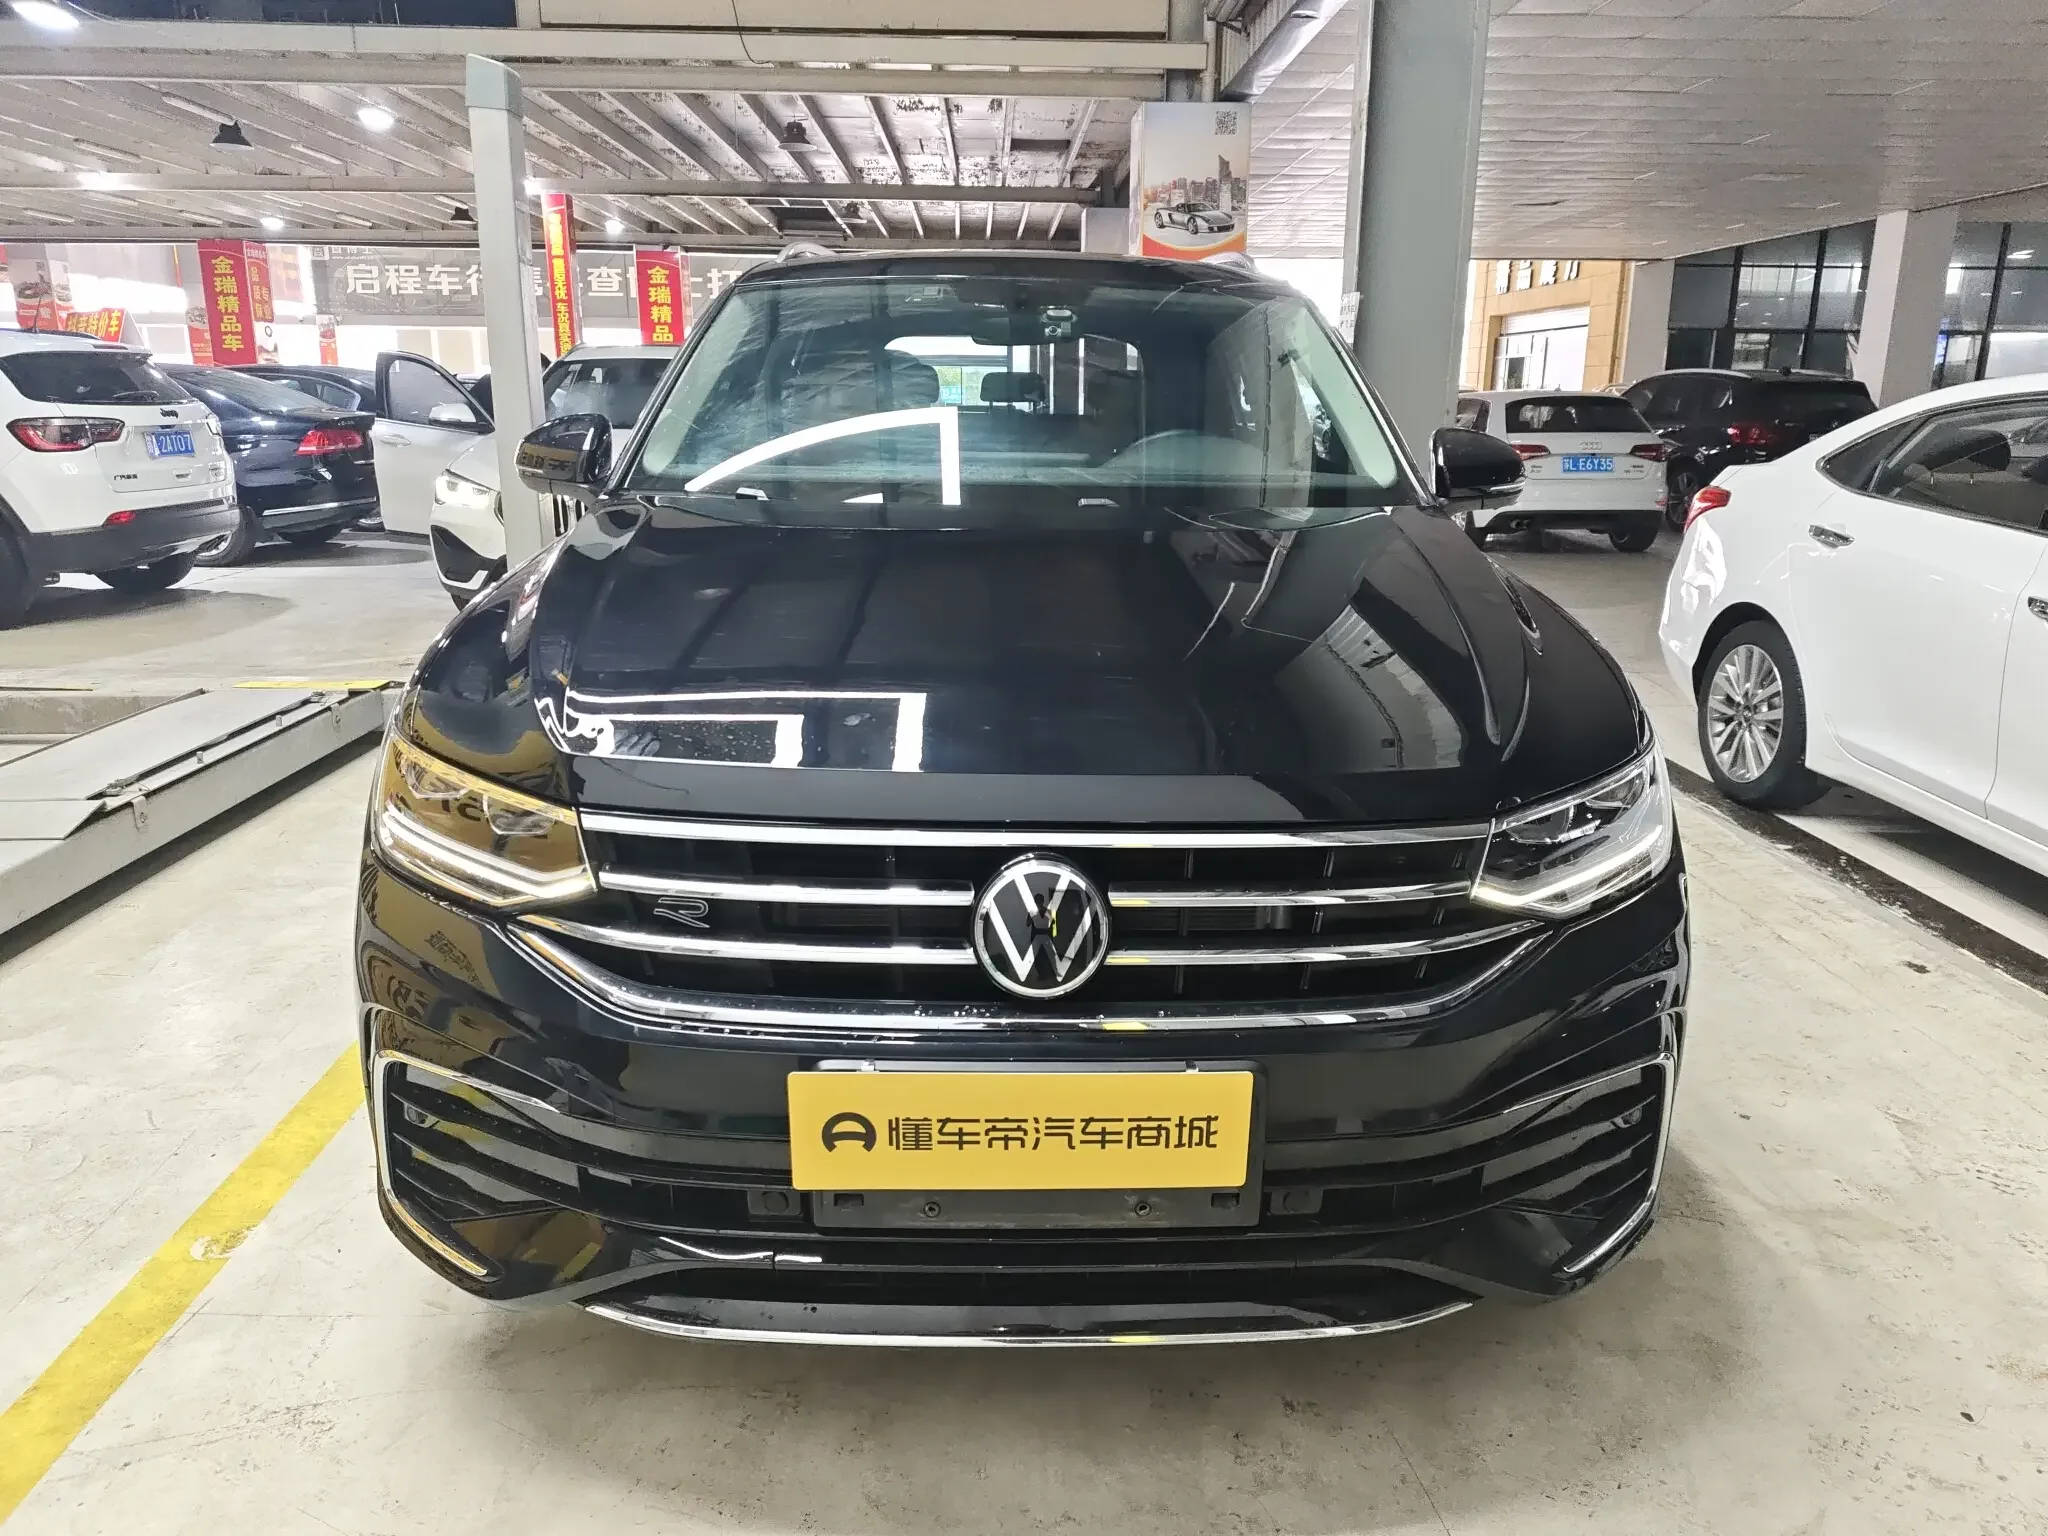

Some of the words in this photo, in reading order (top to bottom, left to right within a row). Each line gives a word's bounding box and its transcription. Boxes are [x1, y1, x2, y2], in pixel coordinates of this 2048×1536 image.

[211, 255, 245, 352] 金瑞精品车
[648, 265, 674, 343] 金瑞精品
[887, 1115, 1220, 1151] 懂车帝汽车商城
